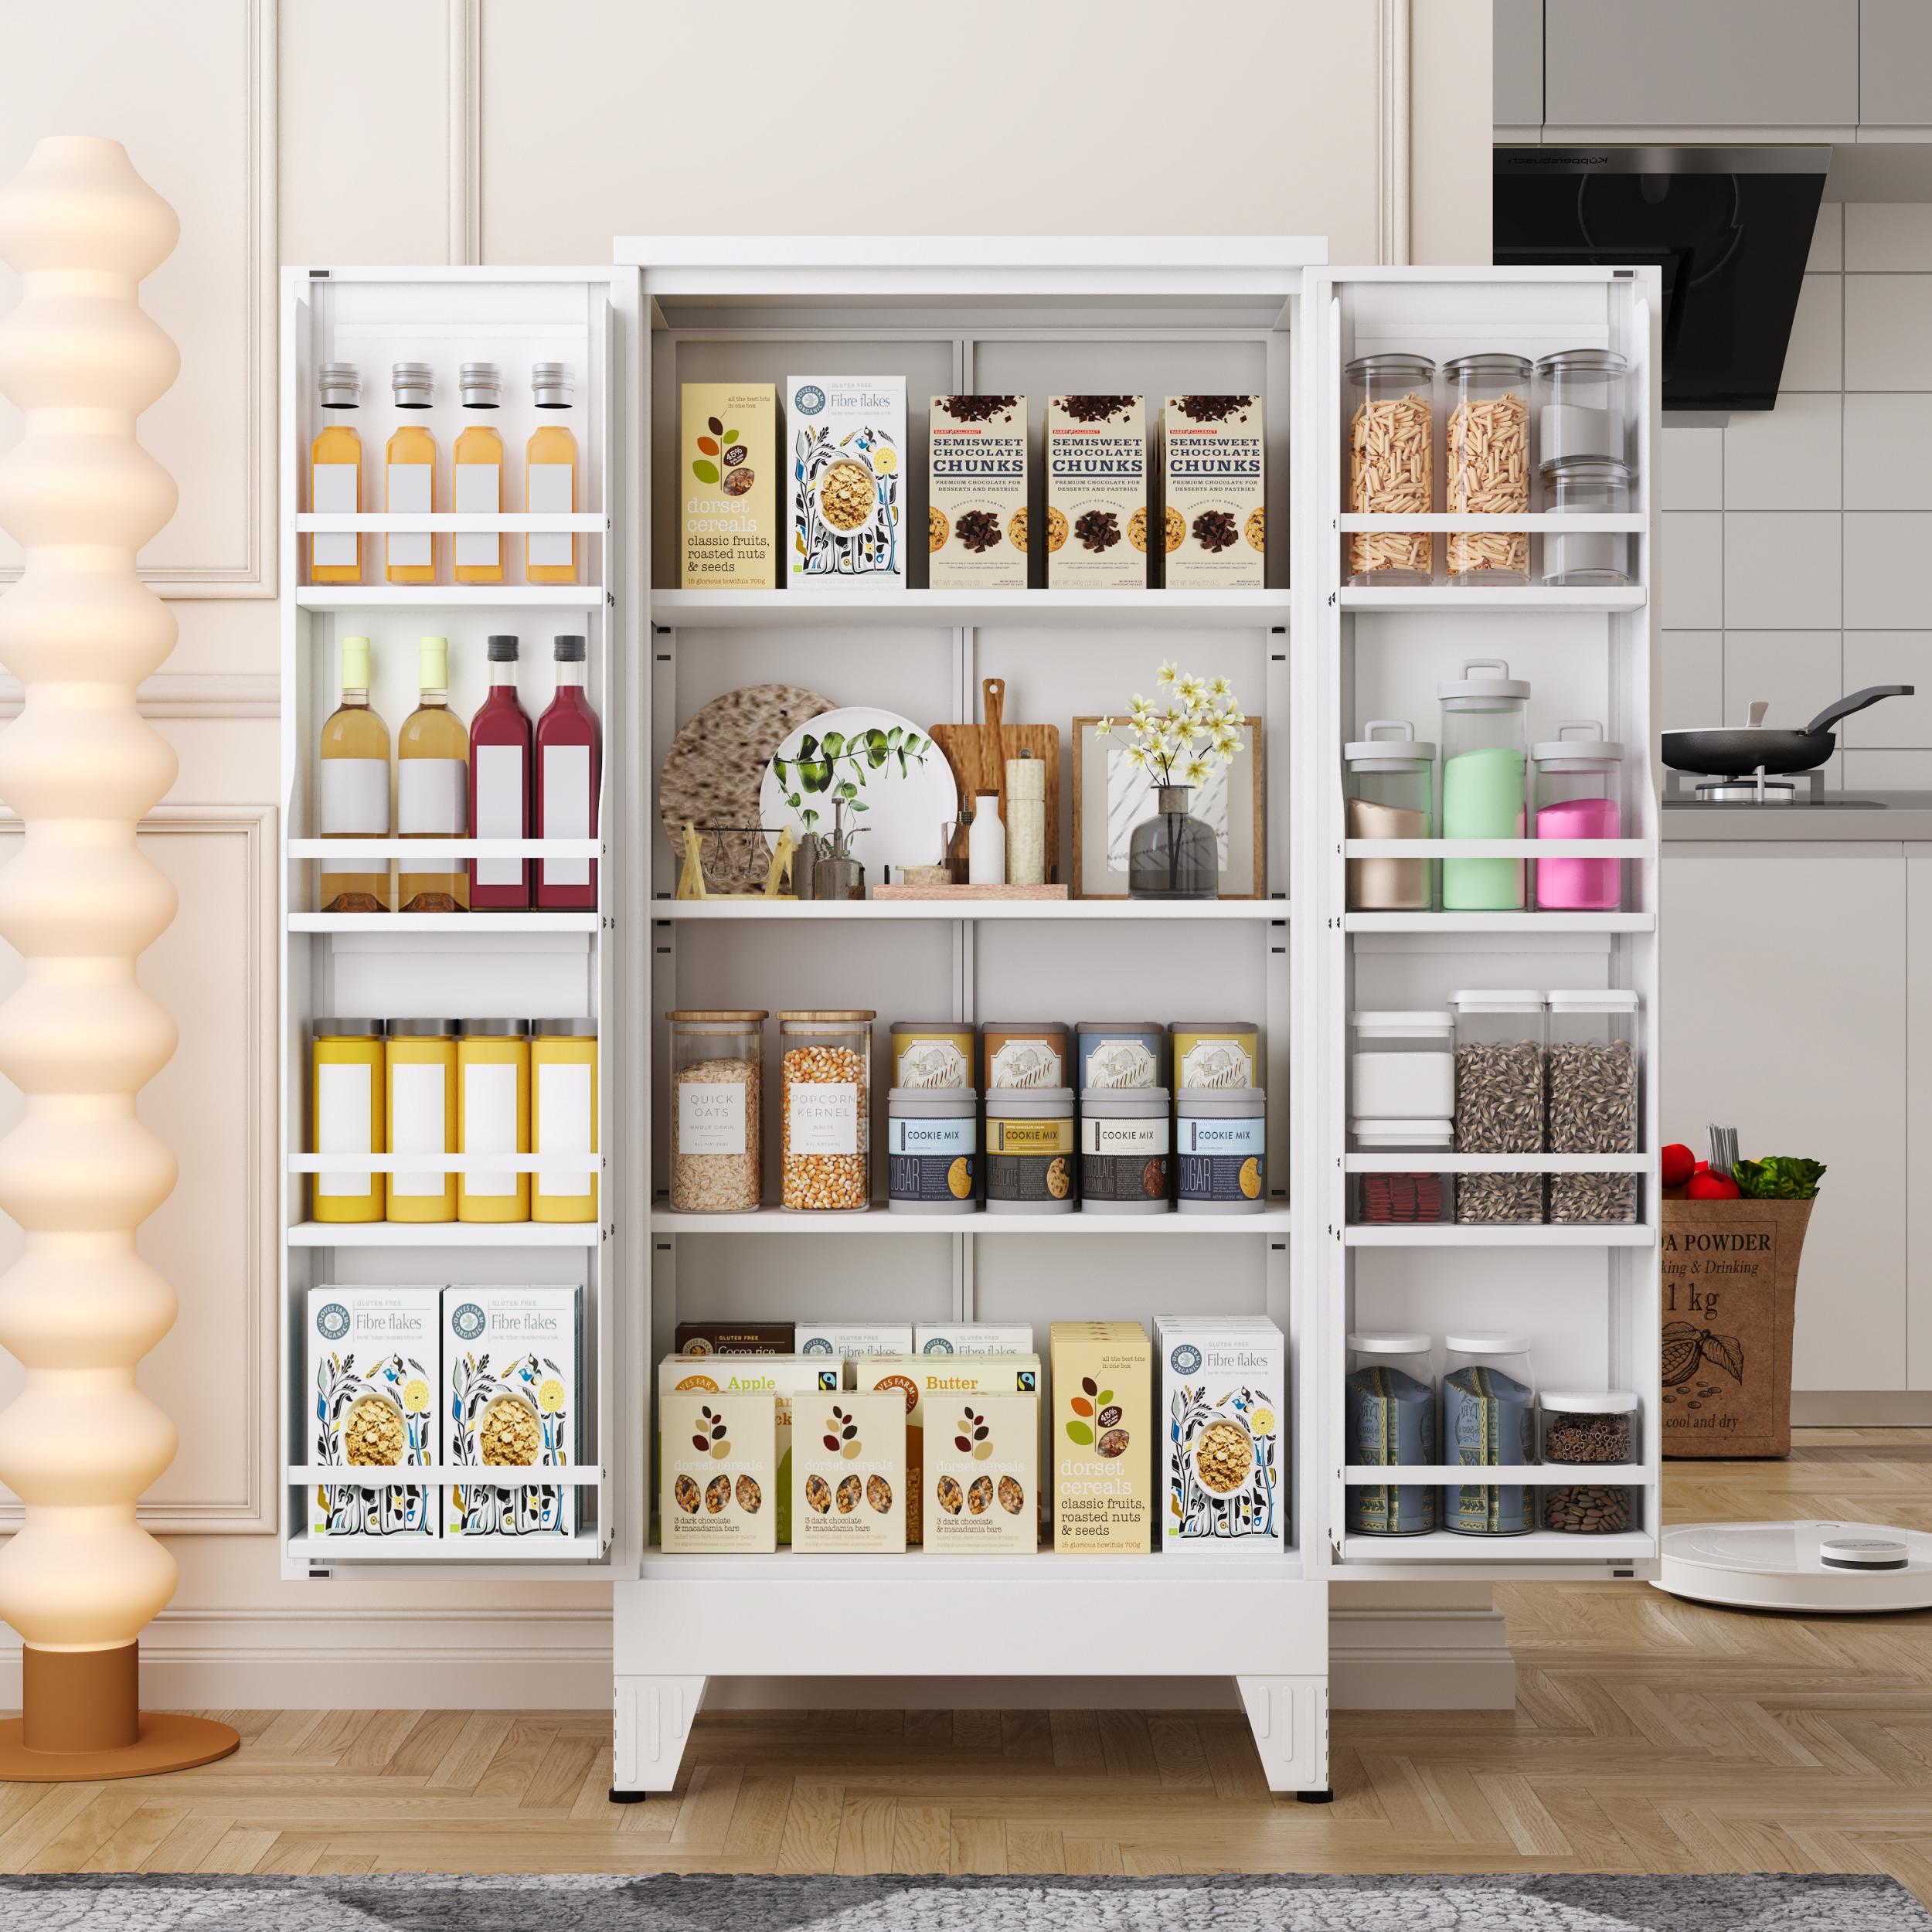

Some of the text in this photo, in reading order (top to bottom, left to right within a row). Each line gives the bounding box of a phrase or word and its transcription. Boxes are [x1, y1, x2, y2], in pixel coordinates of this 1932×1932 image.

[797, 387, 811, 402] DOVES
[831, 393, 890, 406] Fibre flakes
[798, 403, 823, 414] ORGANIC
[934, 460, 1023, 471] CHUNKS
[1053, 460, 1142, 471] CHUNKS
[1170, 460, 1260, 471] CHUNKS
[687, 498, 750, 513] dorset
[687, 516, 757, 532] cereals
[688, 536, 770, 547] classic fruits,
[688, 549, 766, 559] roasted nuts
[688, 562, 735, 572] & seeds
[690, 1094, 733, 1104] QUICK
[792, 1094, 855, 1104] POPCORN
[694, 1107, 729, 1117] OATS
[798, 1108, 850, 1117] KERNEL
[907, 1131, 941, 1140] COOKIE
[1006, 1131, 1039, 1140] COOKIE
[1102, 1131, 1136, 1140] COOKIE
[1199, 1131, 1233, 1140] COOKIE
[890, 1157, 920, 1192] SUGAR
[1179, 1157, 1211, 1192] SUGAR
[1684, 1234, 1771, 1251] POWDER
[1662, 1260, 1759, 1277] king & Drinking
[1667, 1282, 1719, 1321] 1 kg
[318, 1305, 335, 1322] DOVES
[454, 1305, 470, 1322] DOVES
[356, 1313, 422, 1329] Fibre flakes
[492, 1313, 557, 1329] Fibre flakes
[320, 1325, 348, 1338] ORGANIC
[455, 1325, 483, 1338] ORGANIC
[838, 1345, 864, 1357] Fibre
[1172, 1346, 1187, 1362] DOVES
[1207, 1352, 1268, 1366] Fibre flakes
[1174, 1362, 1199, 1373] ORGANIC
[727, 1376, 776, 1391] Apple
[926, 1376, 978, 1389] Butter
[1666, 1413, 1739, 1432] cool and dry
[1060, 1459, 1124, 1475] dorset
[1060, 1478, 1132, 1495] cereals
[1061, 1498, 1145, 1510] classic fruits,
[1061, 1512, 1141, 1522] roasted nuts
[1061, 1525, 1110, 1536] & seeds
